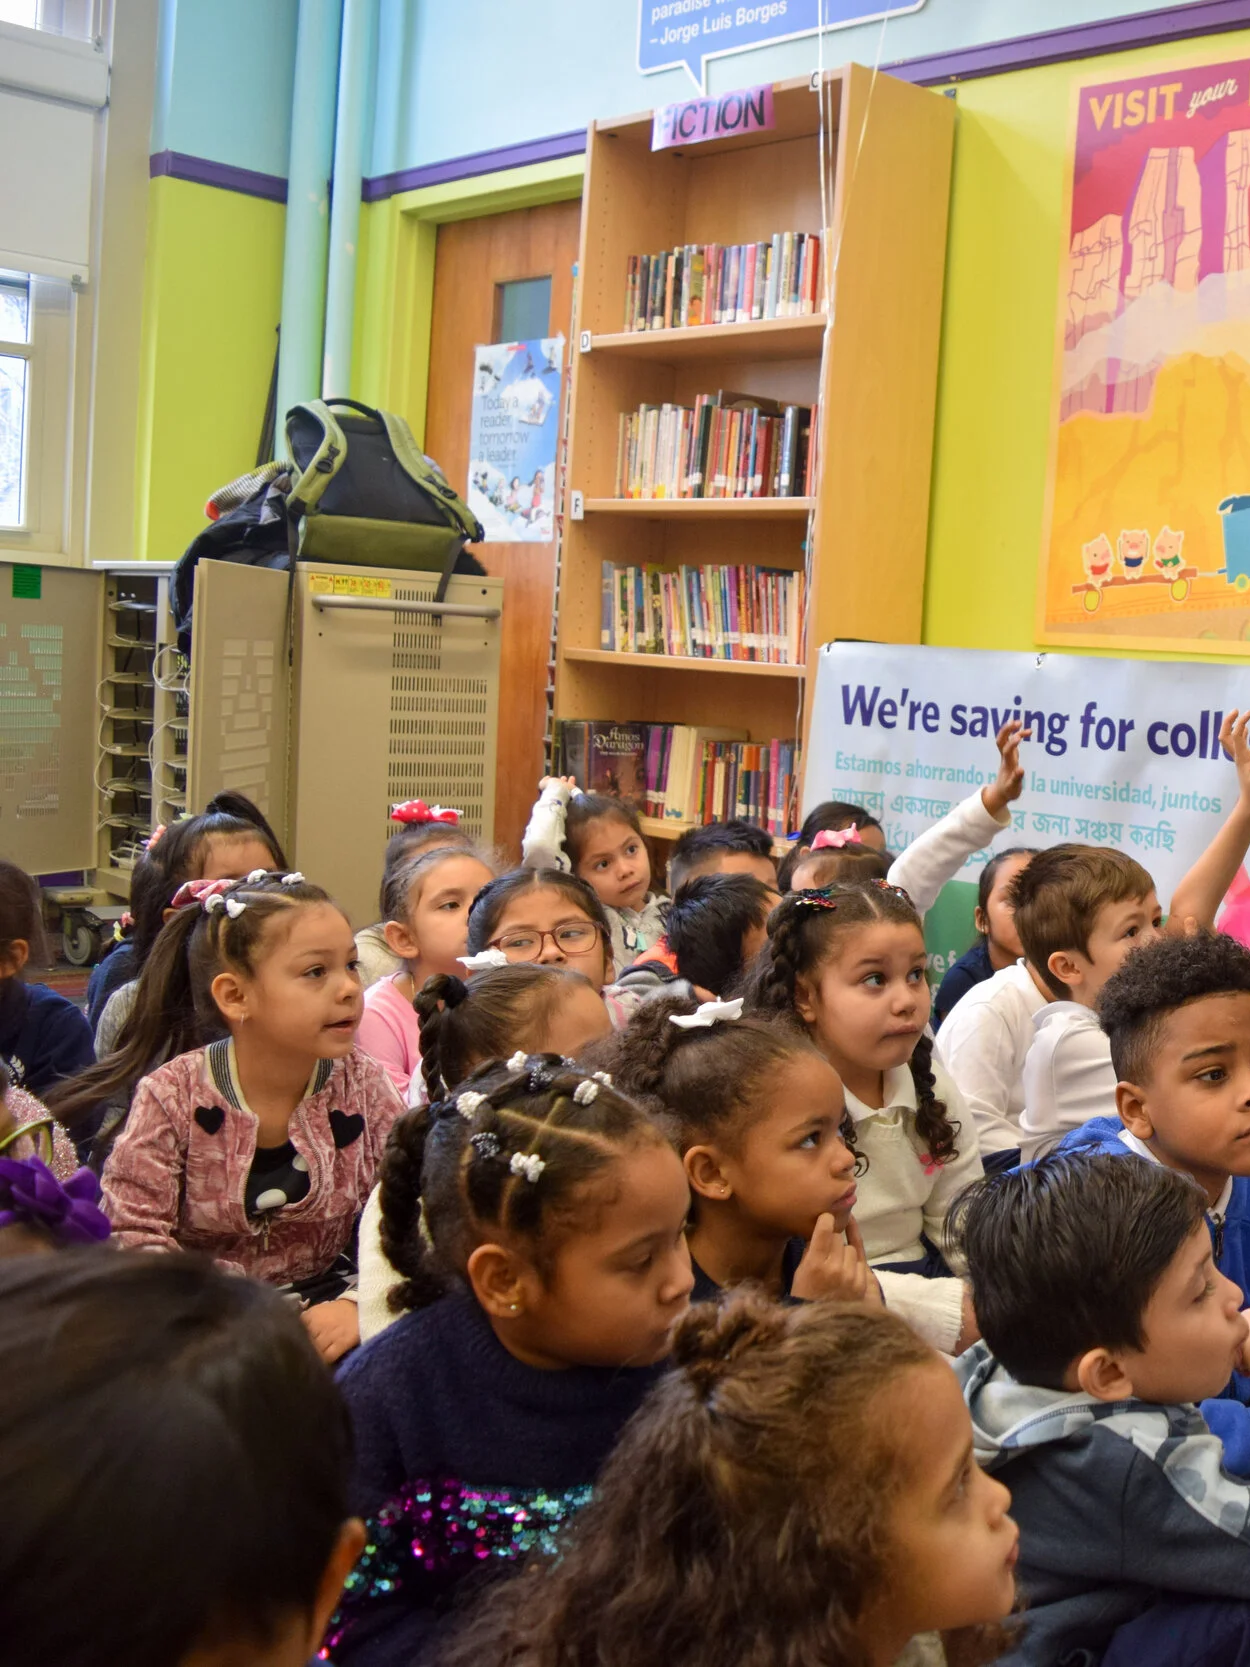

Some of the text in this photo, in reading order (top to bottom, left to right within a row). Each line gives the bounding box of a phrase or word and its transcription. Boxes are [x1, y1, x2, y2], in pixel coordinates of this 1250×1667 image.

[660, 23, 699, 45] Jorge
[702, 13, 732, 34] Luis
[736, 1, 787, 26] Borges
[1089, 83, 1182, 131] VISIT
[1186, 78, 1238, 119] your
[581, 334, 589, 348] D
[481, 396, 510, 411] Today
[479, 430, 529, 446] tomorrow
[574, 498, 580, 513] F
[841, 684, 940, 733] We're
[949, 694, 1070, 757] saving
[1080, 702, 1135, 753] for
[609, 726, 641, 741] Amos
[835, 751, 901, 776] Estamos
[905, 758, 984, 785] ahorrando
[1031, 771, 1046, 792] la
[1050, 775, 1156, 809] universidad,
[1159, 786, 1223, 814] juntos
